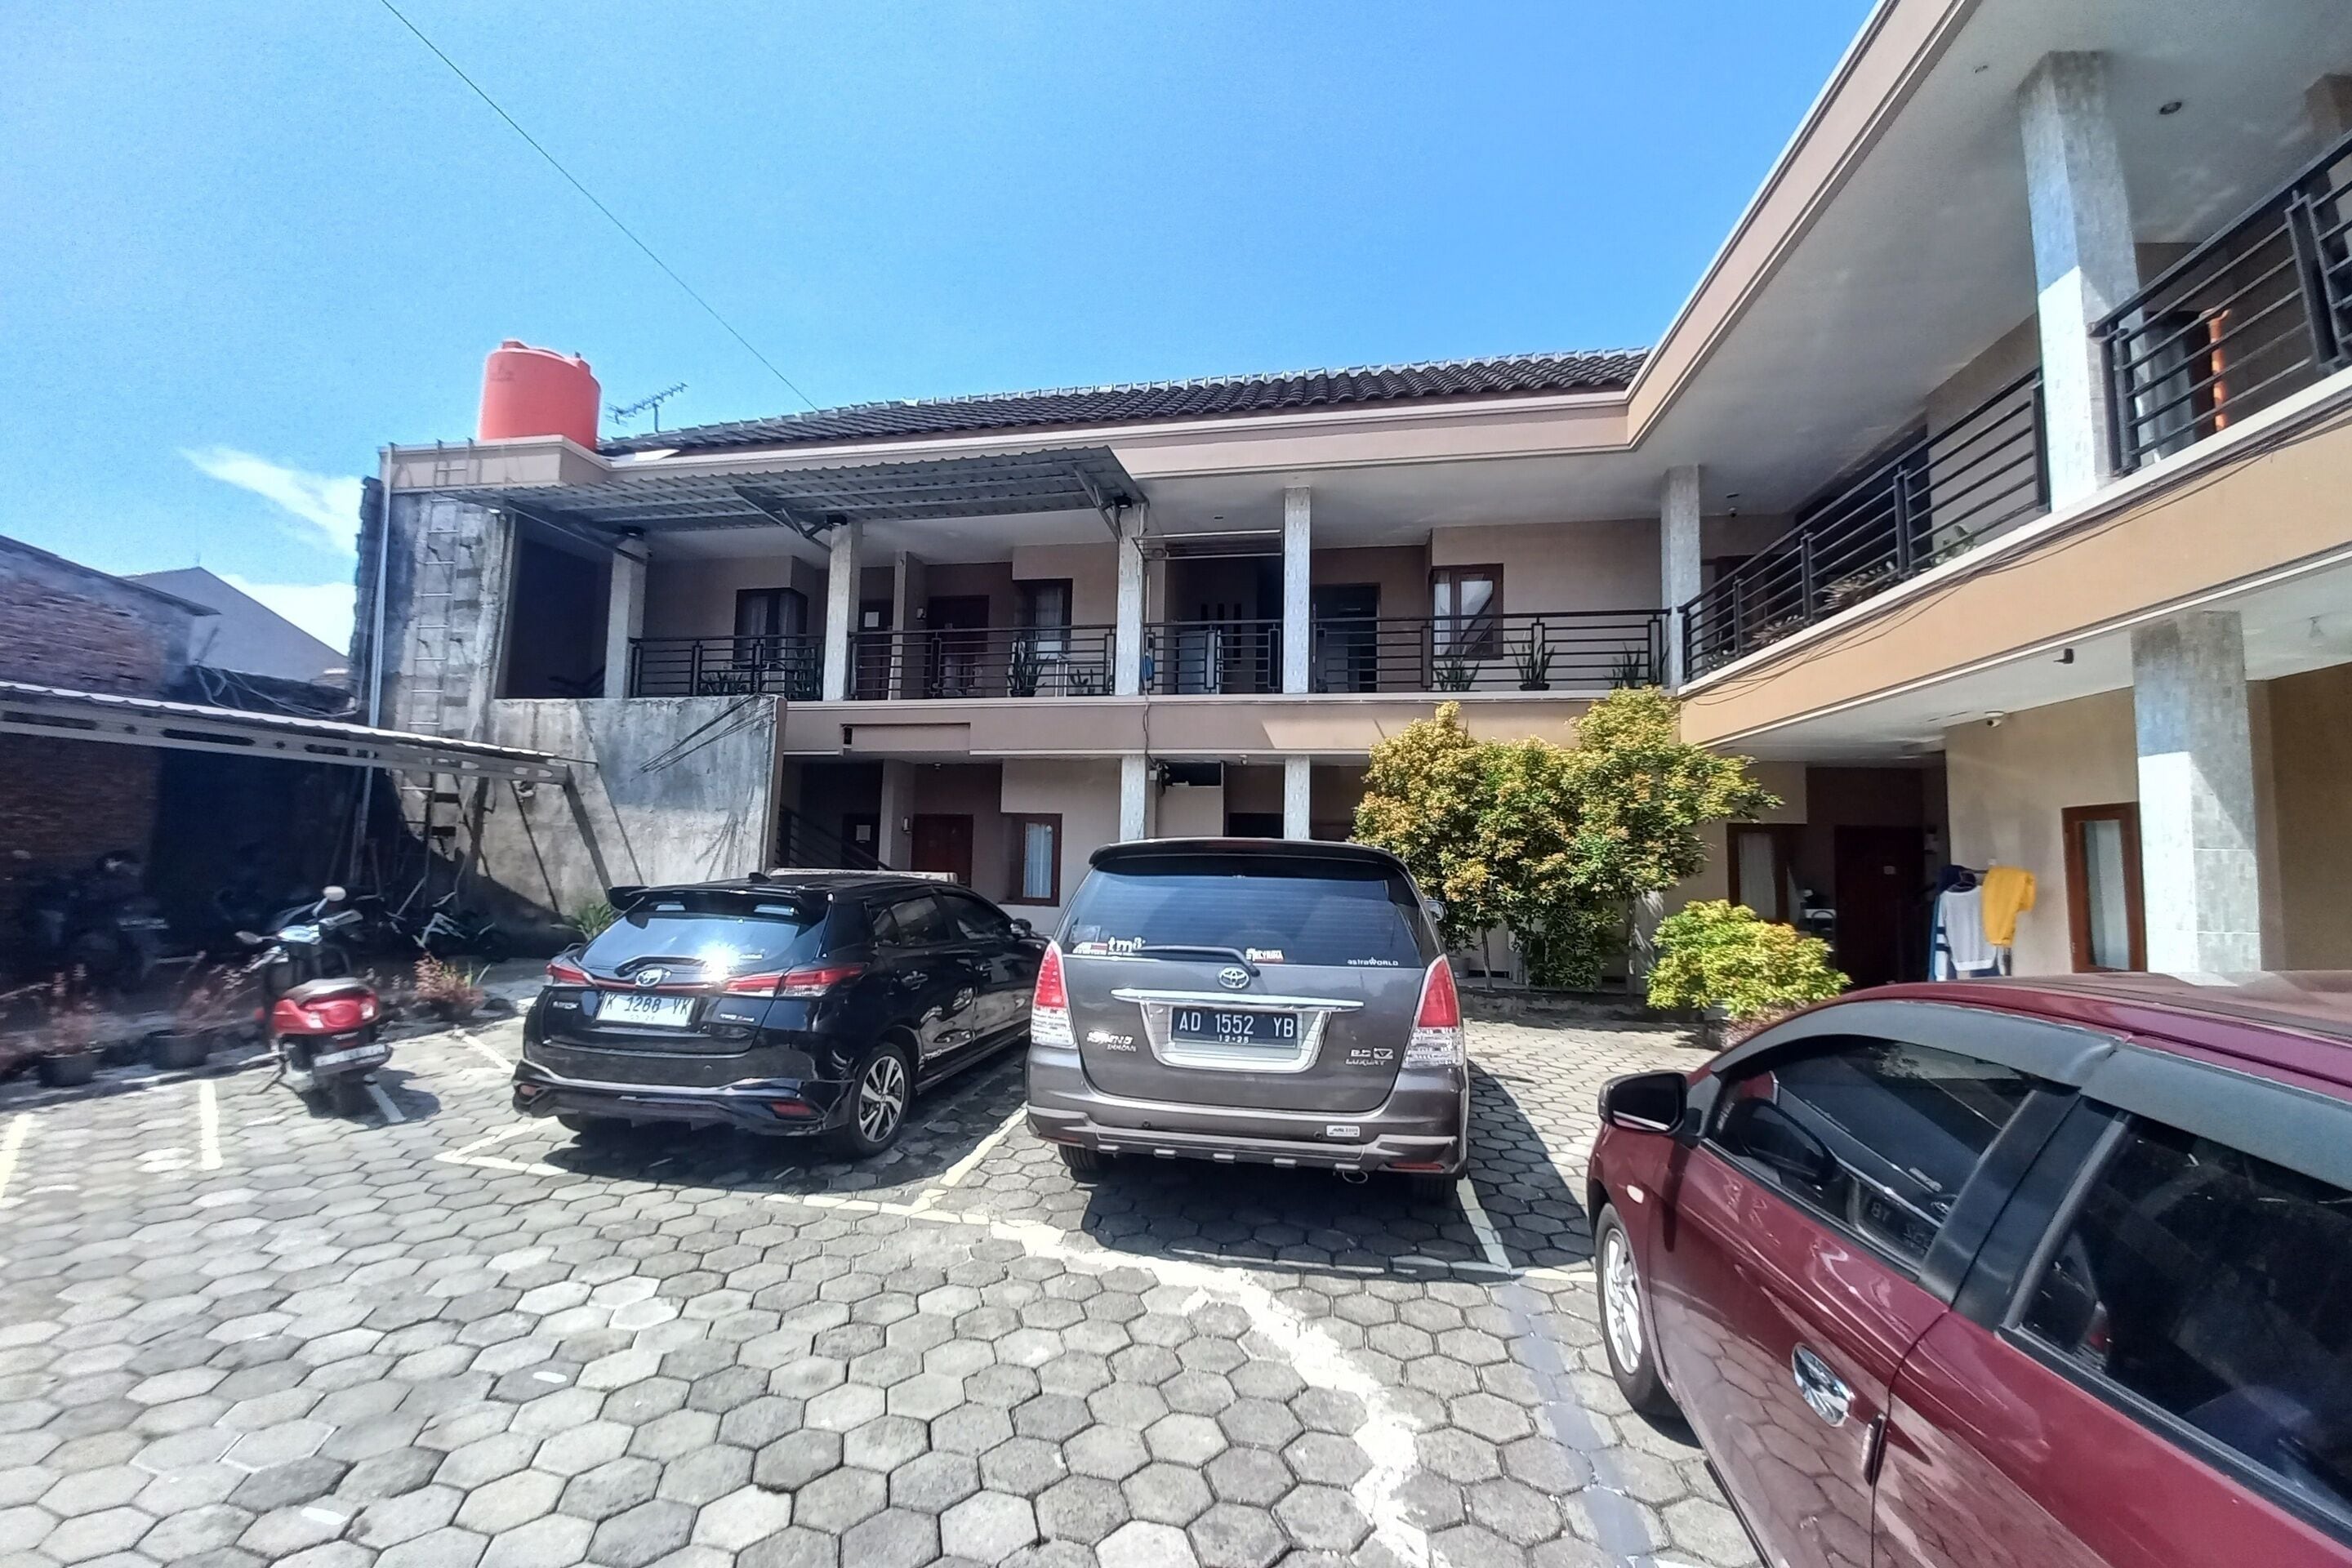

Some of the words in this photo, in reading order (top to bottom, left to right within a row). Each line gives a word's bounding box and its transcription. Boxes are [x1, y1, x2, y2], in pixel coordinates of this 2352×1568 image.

[605, 993, 617, 1009] K
[673, 998, 693, 1015] YK
[1179, 1011, 1201, 1031] AD
[1214, 1013, 1254, 1036] 1552
[1273, 1017, 1294, 1038] YB
